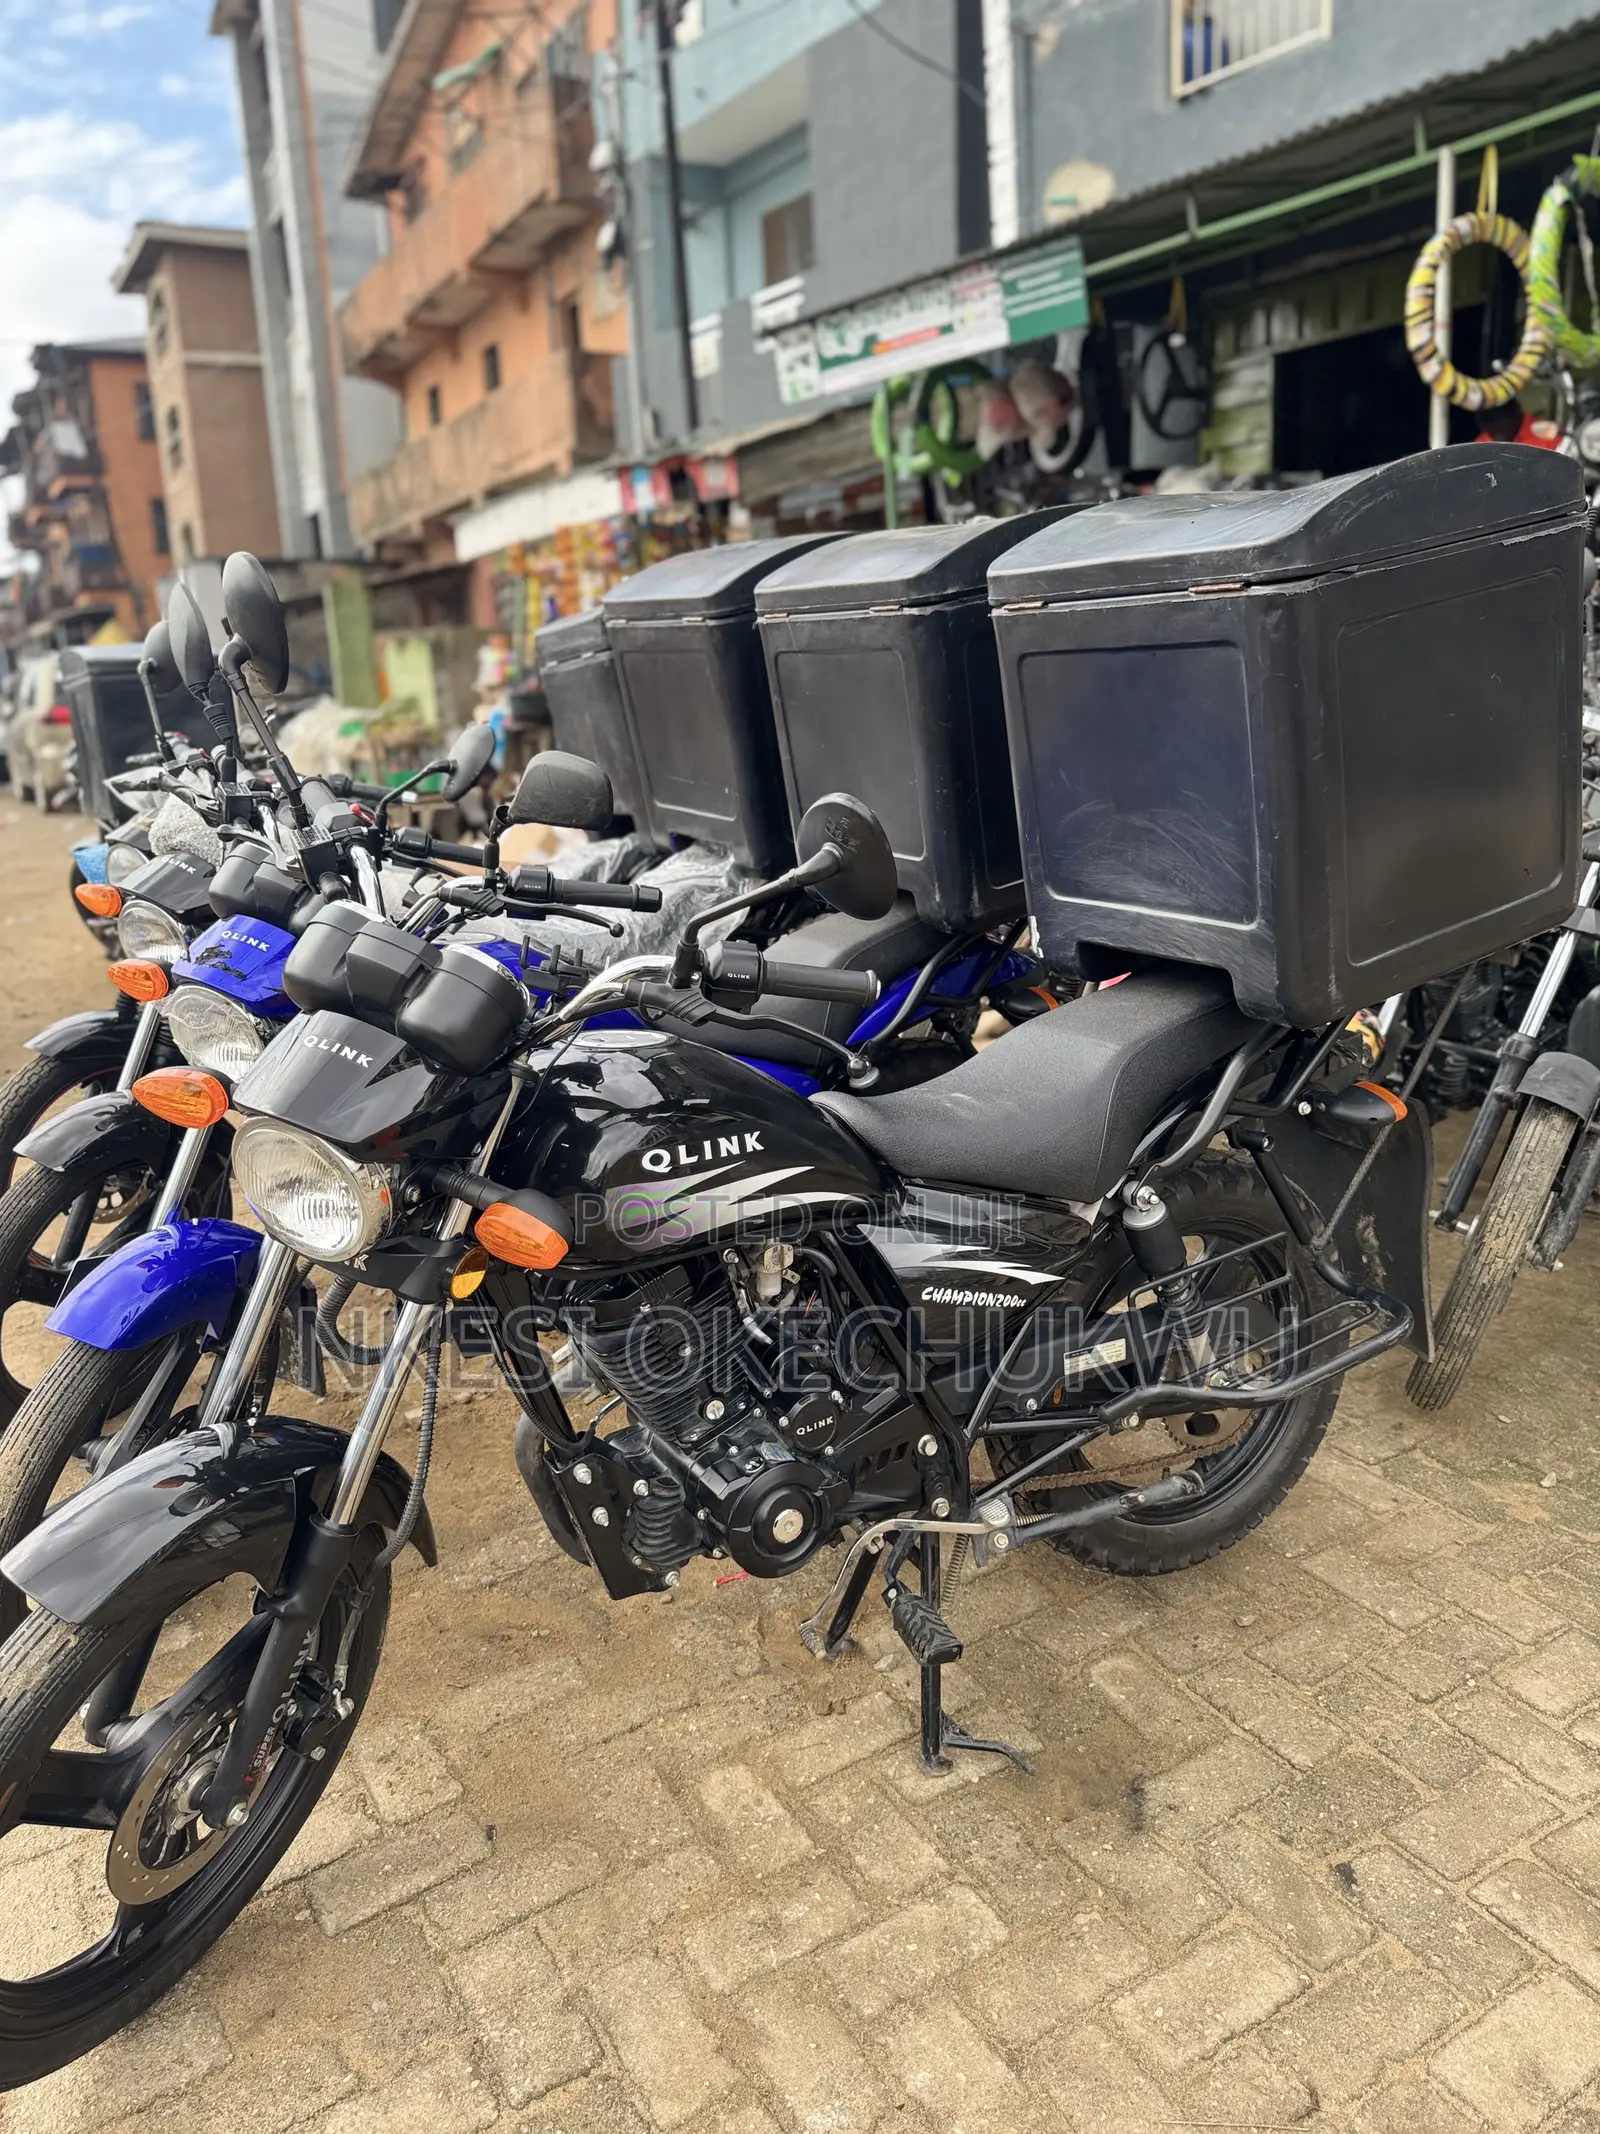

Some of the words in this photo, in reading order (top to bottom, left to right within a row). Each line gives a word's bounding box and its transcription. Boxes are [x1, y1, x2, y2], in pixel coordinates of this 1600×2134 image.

[221, 930, 271, 952] QLINK
[727, 972, 751, 980] QLINK
[303, 1035, 374, 1068] QLINK
[641, 1130, 765, 1173] QLINK
[796, 1416, 833, 1435] QLINK
[253, 1726, 277, 1768] SUPER
